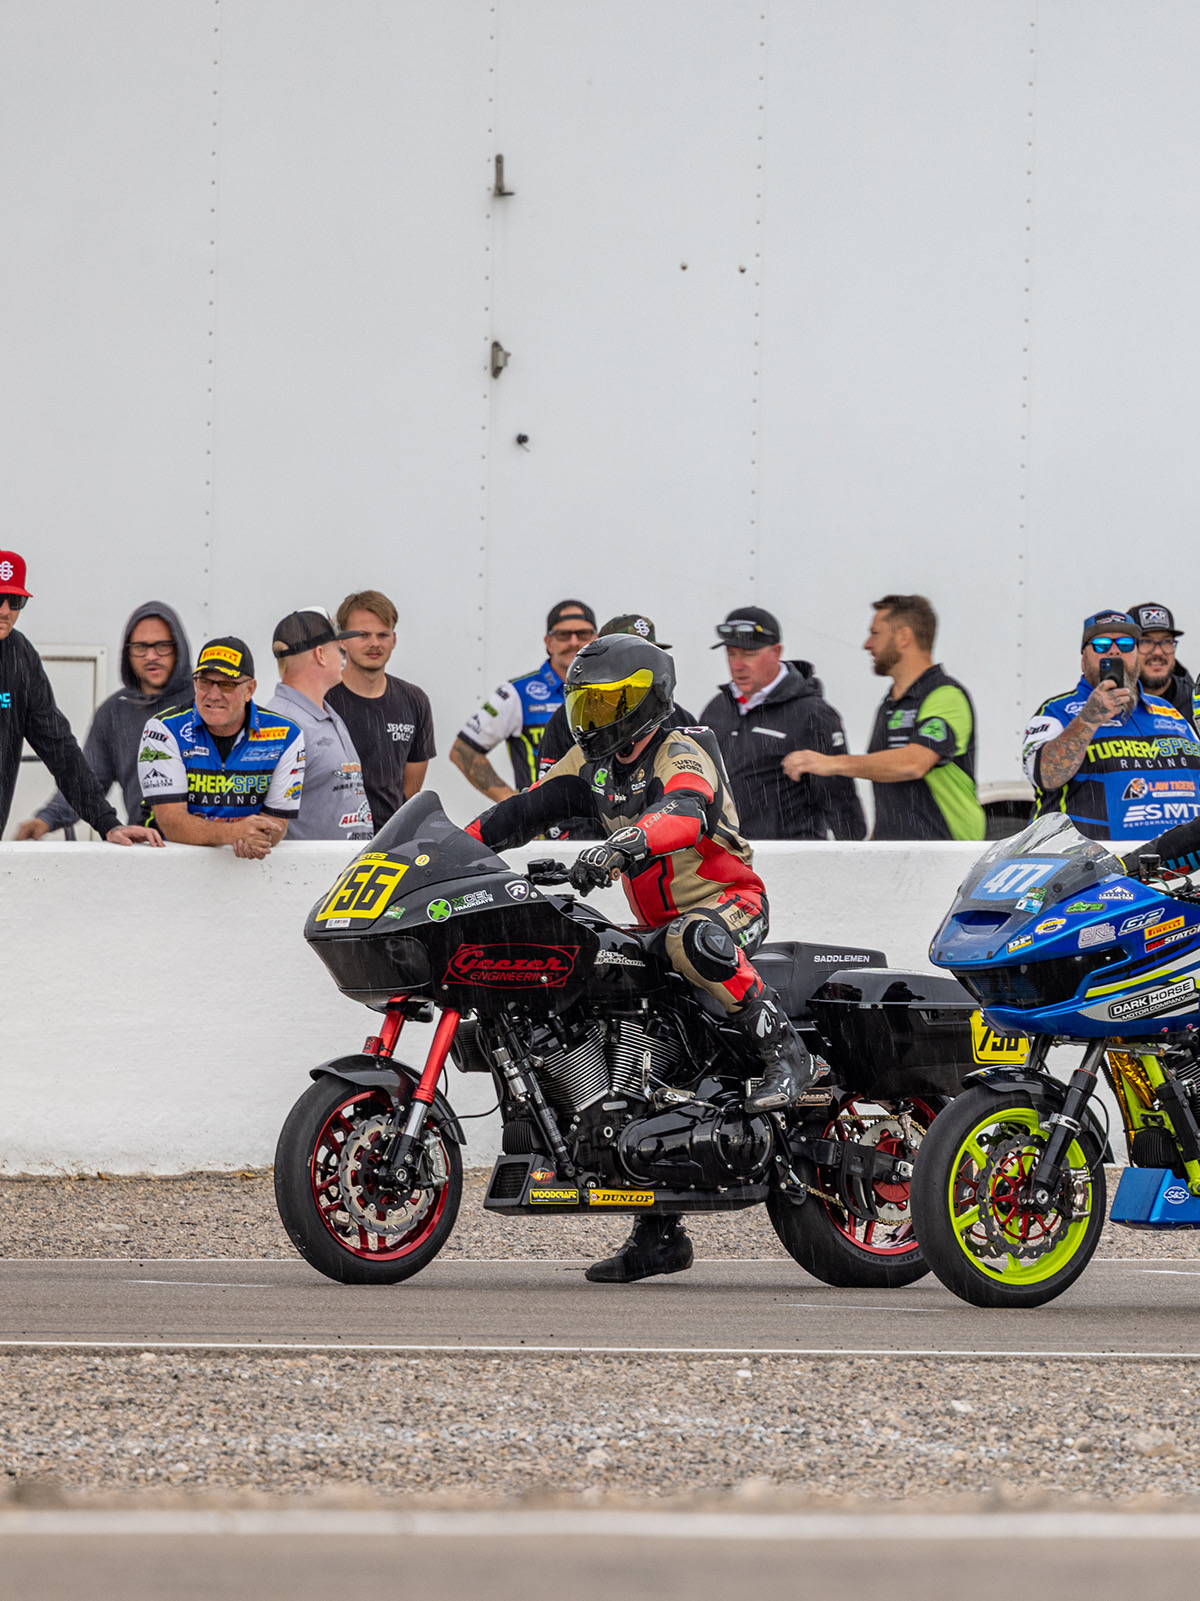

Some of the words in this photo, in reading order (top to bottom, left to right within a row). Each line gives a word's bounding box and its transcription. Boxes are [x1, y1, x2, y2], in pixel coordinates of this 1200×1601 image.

[202, 651, 239, 663] PIRELLI
[1086, 739, 1151, 763] TUCKER
[1120, 757, 1188, 769] RACING
[187, 773, 227, 793] CKER
[1148, 782, 1168, 791] LAW
[1169, 781, 1196, 791] TIGERS
[188, 794, 258, 806] RACING
[643, 800, 679, 829] DAINESE
[983, 864, 1054, 893] 477
[454, 896, 494, 911] TRACKDAYS
[1148, 918, 1182, 937] PIRELLI
[453, 949, 569, 971] Geezer
[813, 955, 870, 963] SADDLEMEN
[470, 971, 555, 982] ENGINEERING
[1112, 998, 1149, 1015] DARK
[1151, 981, 1192, 1004] HORSE
[1121, 1007, 1150, 1021] MOTOR
[1149, 995, 1186, 1012] COMPANY
[532, 1191, 577, 1199] WOODCRAFT
[601, 1193, 654, 1203] DUNLOP
[1167, 1188, 1187, 1201] S&S
